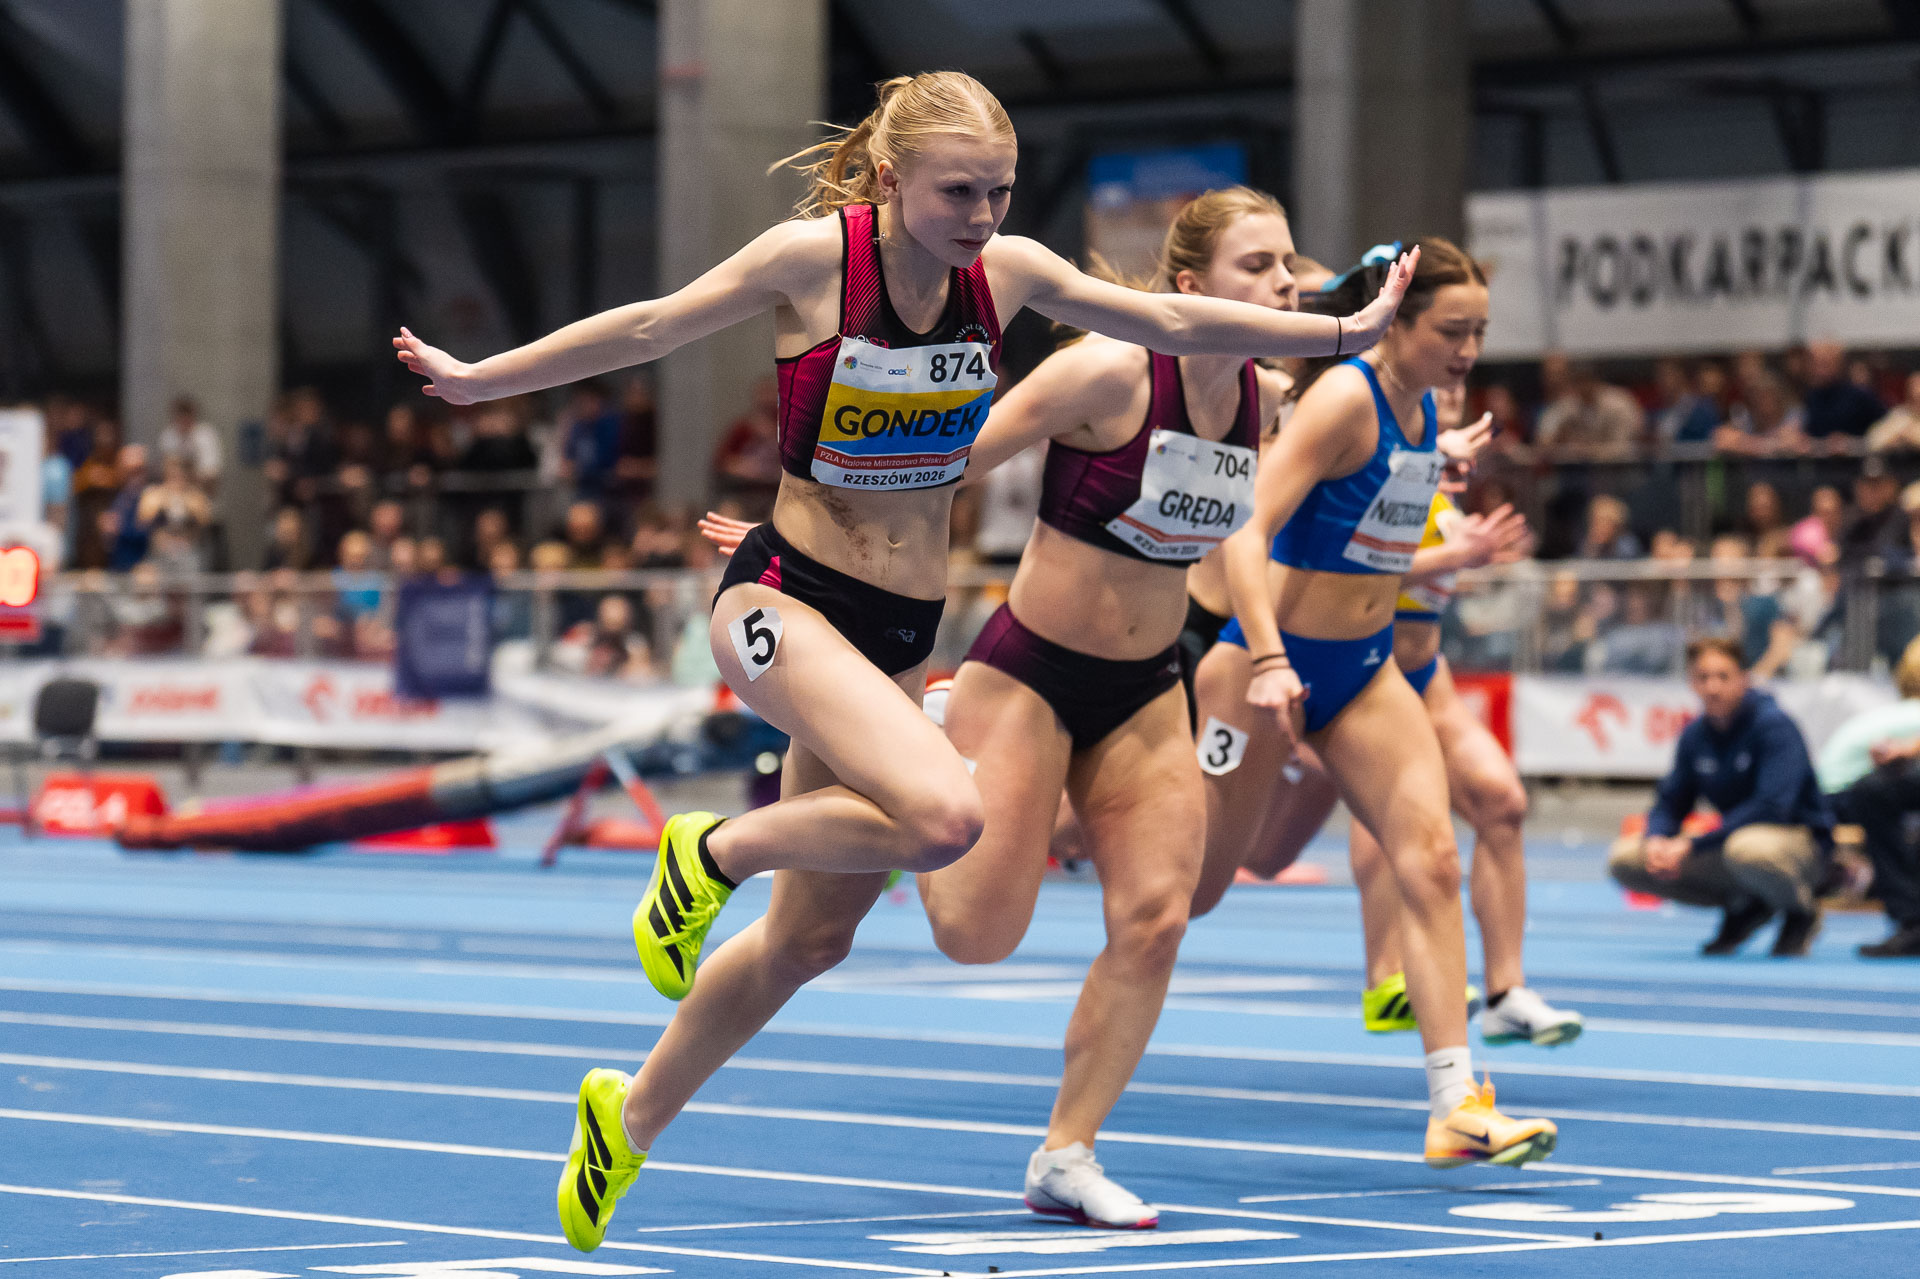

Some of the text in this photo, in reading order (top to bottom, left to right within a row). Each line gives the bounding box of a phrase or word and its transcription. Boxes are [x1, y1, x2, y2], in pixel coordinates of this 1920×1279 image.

[929, 351, 986, 383] 874
[834, 404, 982, 438] GONDEK
[841, 457, 872, 468] Halowe
[873, 458, 918, 468] Mistrzostwa
[919, 456, 943, 465] Polski
[842, 470, 946, 486] RZESZÓW 2026
[1213, 450, 1250, 481] 704
[1158, 489, 1236, 529] GRĘDA
[743, 608, 775, 665] 5
[1207, 728, 1233, 767] 3
